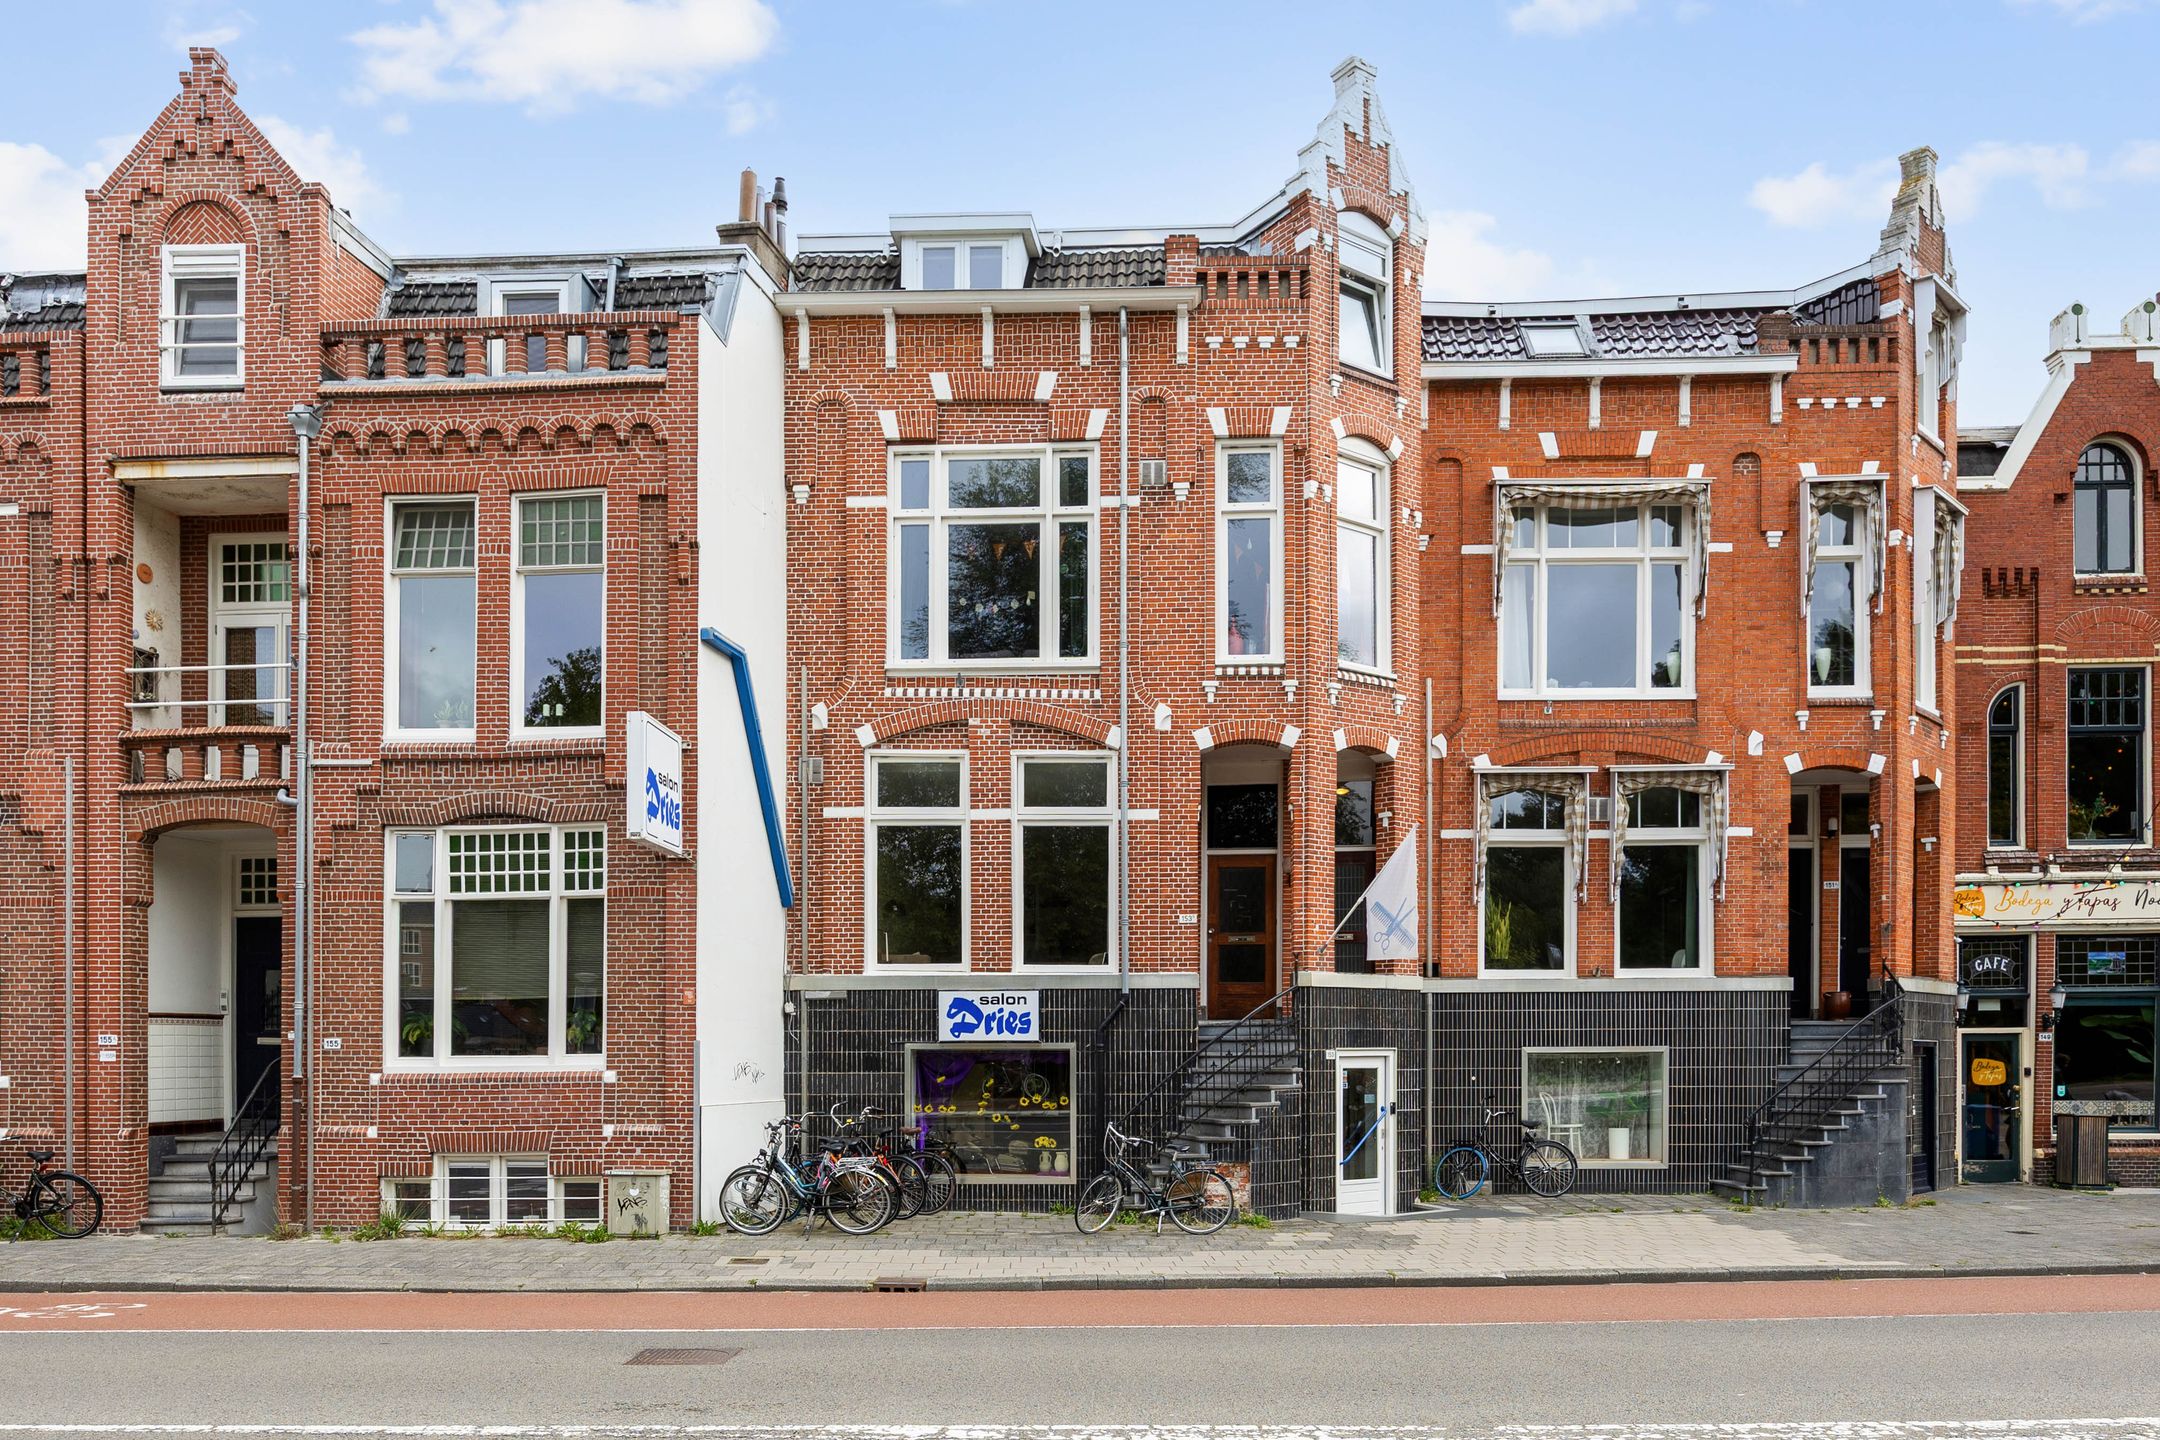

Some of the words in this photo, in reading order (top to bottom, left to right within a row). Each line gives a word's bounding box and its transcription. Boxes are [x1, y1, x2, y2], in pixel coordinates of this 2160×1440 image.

[658, 772, 678, 792] salon
[646, 767, 680, 830] Dries
[1994, 888, 2053, 915] Bodega
[2060, 897, 2074, 914] y
[2073, 886, 2121, 917] Tapas
[979, 993, 1027, 1006] salon
[946, 997, 1032, 1039] Dries
[326, 1040, 339, 1048] 155
